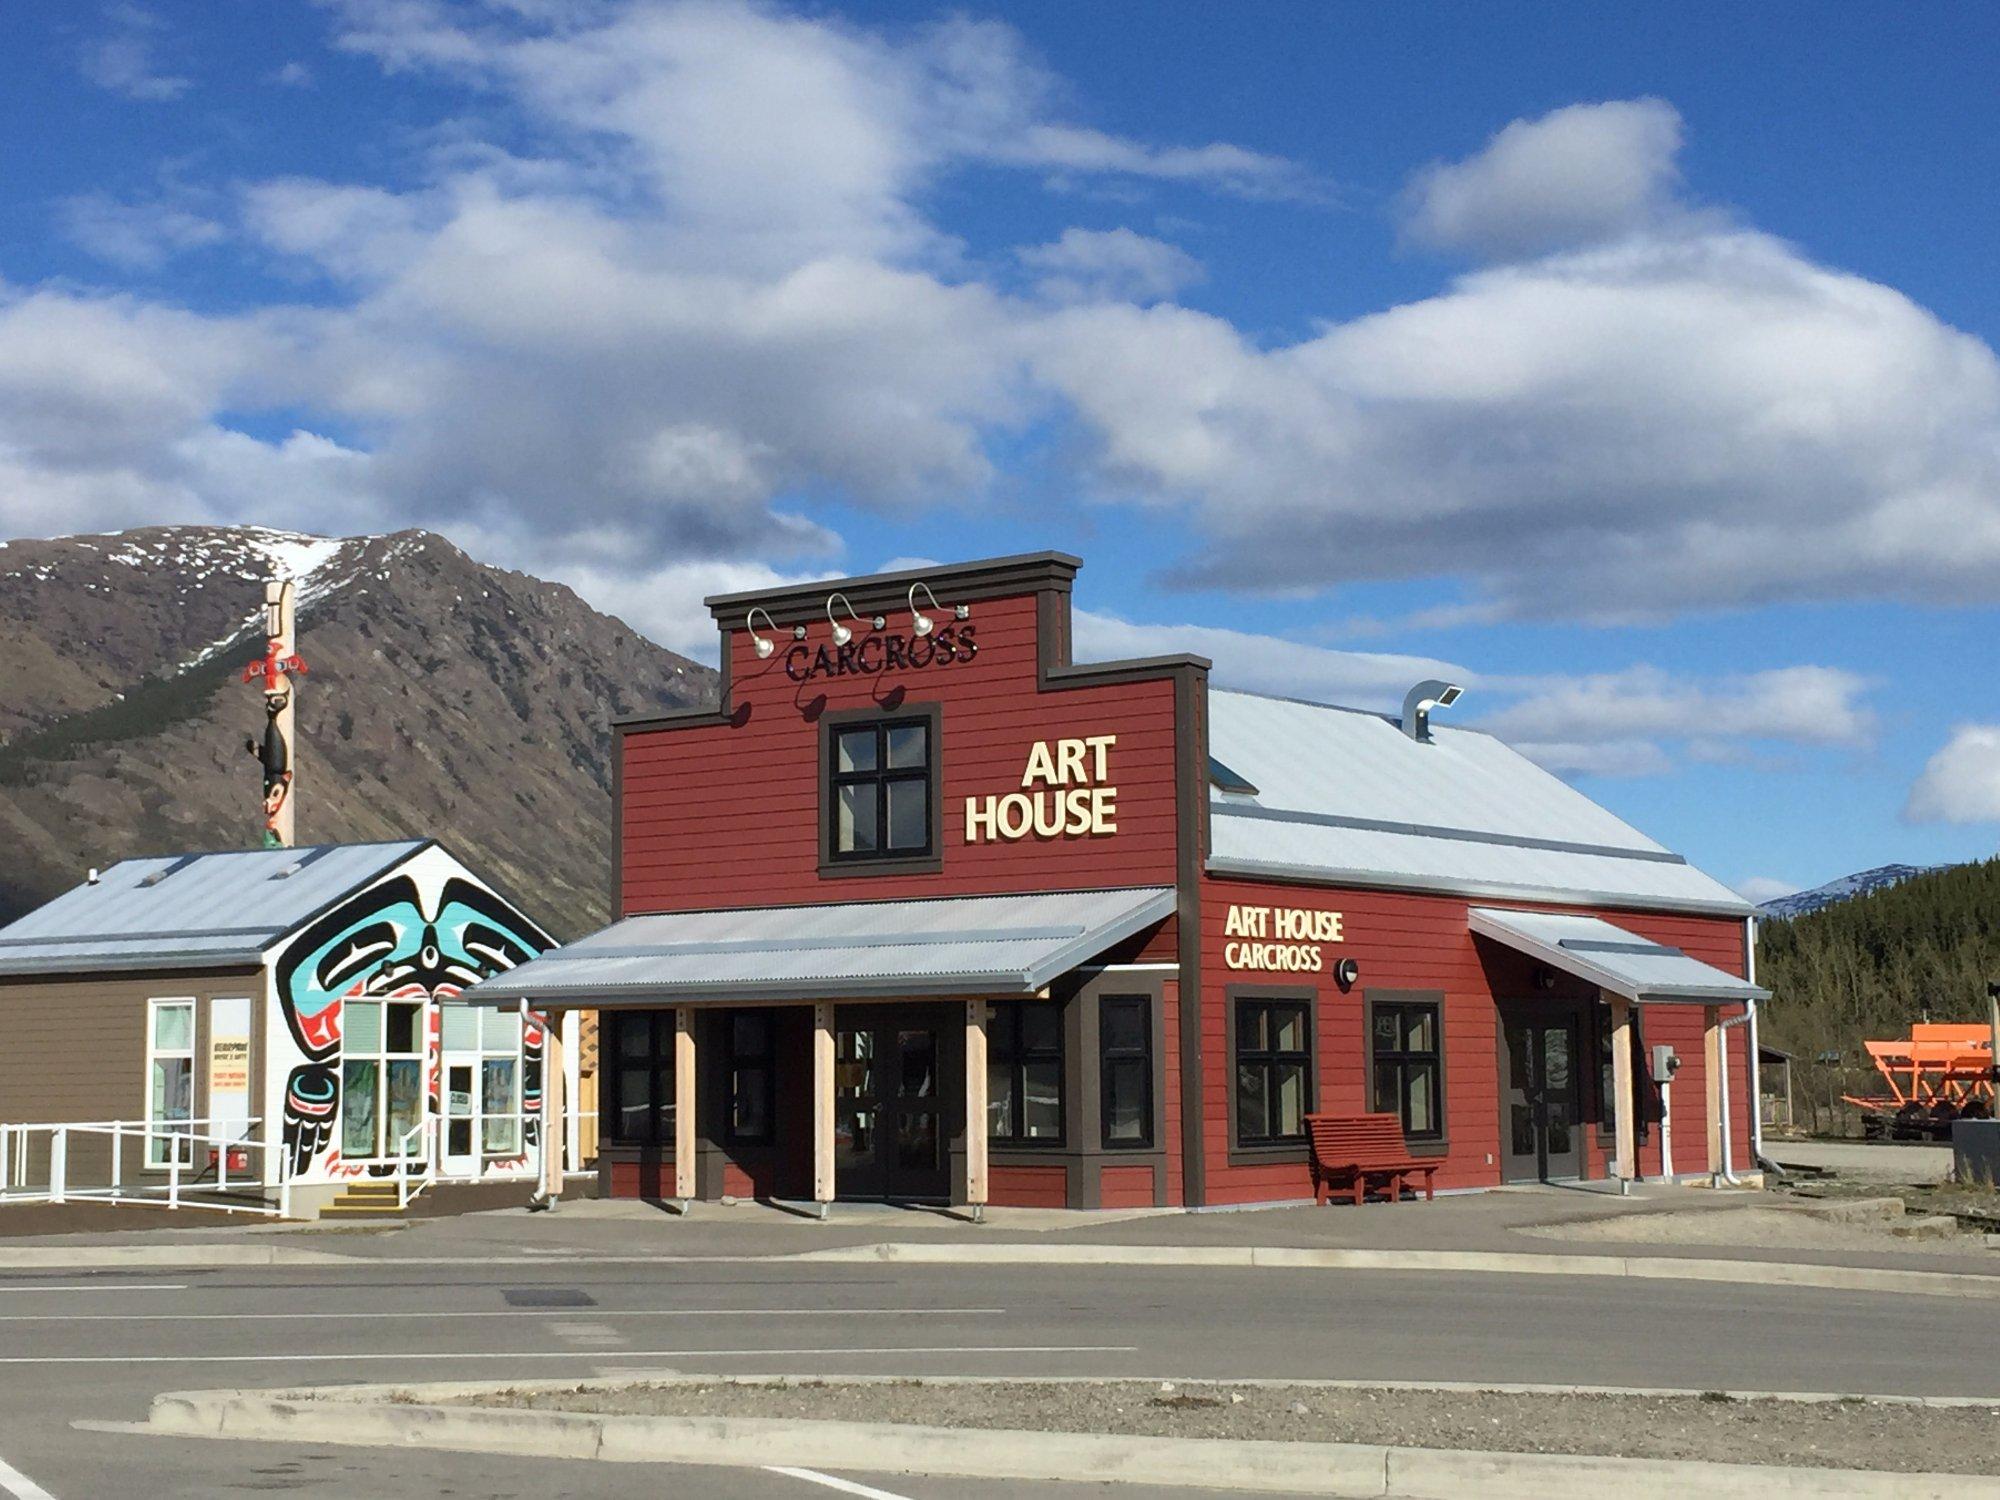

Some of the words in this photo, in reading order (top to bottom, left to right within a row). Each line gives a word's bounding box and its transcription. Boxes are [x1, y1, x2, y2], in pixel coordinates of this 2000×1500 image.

[786, 625, 979, 681] CARCROSS
[1021, 734, 1117, 788] ART
[965, 787, 1118, 842] HOUSE
[1224, 904, 1270, 938] ART
[1274, 908, 1344, 942] HOUSE
[1224, 942, 1322, 972] CARCROSS
